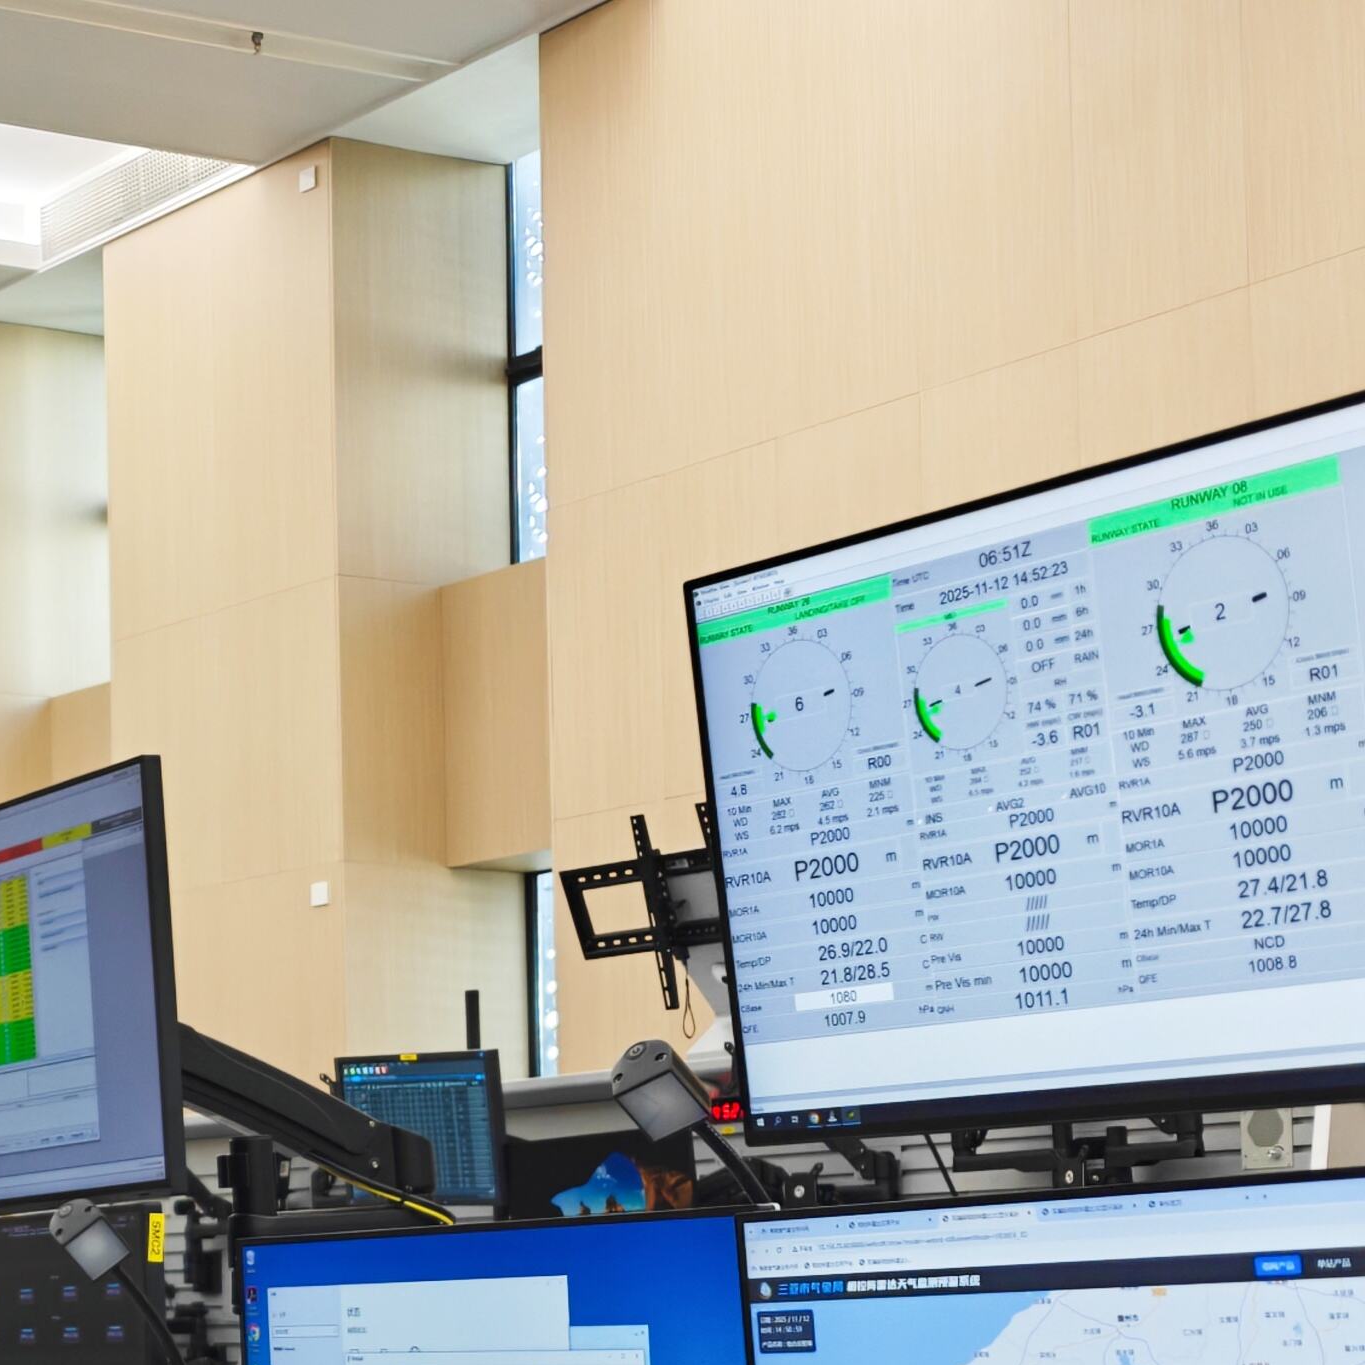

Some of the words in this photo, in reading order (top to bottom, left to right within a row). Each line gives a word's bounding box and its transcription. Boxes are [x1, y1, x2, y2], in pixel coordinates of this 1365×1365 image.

[1170, 485, 1229, 511] RUNWAY
[1232, 480, 1248, 495] 08
[1232, 495, 1254, 508] NOT
[1255, 491, 1267, 502] IN
[1268, 485, 1288, 499] USE
[1091, 527, 1129, 544] RUNWAY
[1131, 519, 1160, 536] STATE
[1206, 520, 1219, 532] 36
[1245, 522, 1259, 534] 03
[979, 541, 1032, 568] 06:51Z
[1170, 541, 1183, 552] 33
[1277, 548, 1291, 560] 06
[940, 575, 1009, 605] 2025-11-12
[1013, 561, 1068, 587] 14:52:23
[1147, 579, 1159, 591] 30
[1020, 595, 1039, 609] 0.0
[1075, 584, 1086, 595] 1h
[1293, 590, 1306, 602] 09
[895, 602, 915, 613] Time
[1215, 603, 1226, 621] 2
[817, 628, 828, 639] 03
[1023, 617, 1042, 631] 0.0
[1142, 624, 1153, 636] 27
[1074, 628, 1094, 641] 24h
[1288, 637, 1301, 648] 12
[841, 651, 852, 662] 06
[1031, 659, 1056, 673] OFF
[1074, 650, 1099, 664] RAIN
[744, 675, 754, 685] 30
[1156, 665, 1169, 677] 24
[1263, 675, 1275, 686] 15
[1309, 664, 1339, 682] R01
[853, 688, 865, 698] 09
[1187, 691, 1198, 702] 21
[1227, 695, 1238, 706] 18
[794, 696, 804, 712] 6
[1028, 701, 1041, 713] 74
[1069, 693, 1082, 704] 71
[1129, 704, 1156, 720] -3.1
[739, 713, 749, 723] 27
[1123, 729, 1135, 741] 10
[1137, 727, 1155, 739] Min
[1183, 716, 1206, 729] MAX
[1246, 705, 1269, 717] AVG
[1307, 692, 1337, 705] MNM
[1032, 730, 1059, 747] -3.6
[1073, 722, 1100, 740] R01
[1131, 742, 1150, 753] WD
[1180, 731, 1199, 744] 287
[1243, 719, 1263, 732] 250
[1307, 707, 1328, 720] 206
[1132, 757, 1151, 768] WS
[1178, 748, 1194, 761] 5.6
[1196, 746, 1217, 758] mps
[1240, 737, 1256, 749] 3.7
[1259, 734, 1281, 747] mps
[1305, 725, 1321, 737] 1.3
[1324, 722, 1346, 734] mps
[831, 760, 842, 769] 15
[867, 755, 891, 770] R00
[1119, 777, 1151, 790] RVR1A
[1232, 750, 1285, 773] P2000
[773, 796, 791, 808] MAX
[822, 787, 840, 798] AVG
[925, 812, 943, 825] INS
[996, 798, 1024, 812] AVG2
[1069, 782, 1107, 799] AVG10
[1121, 802, 1182, 825] RVR10A
[1212, 778, 1293, 814] P2000
[1329, 776, 1344, 790] m
[1009, 807, 1055, 829] P2000
[810, 826, 851, 846] P2000
[1126, 837, 1165, 854] MOR1A
[1229, 814, 1288, 841] 10000
[923, 852, 972, 871] RVR10A
[995, 833, 1060, 863] P2000
[1087, 833, 1099, 844] m
[725, 870, 772, 889] RVR10A
[794, 852, 859, 882] P2000
[886, 851, 897, 862] m
[1129, 865, 1175, 881] MOR10A
[1233, 844, 1292, 869] 10000
[926, 886, 966, 900] MOR10A
[1005, 867, 1057, 891] 10000
[1131, 894, 1177, 910] Temp/DP
[1238, 869, 1329, 900] 27.4/21.8
[809, 887, 854, 908] 10000
[812, 914, 857, 936] 10000
[1134, 928, 1154, 940] 24h
[1157, 921, 1202, 938] Min/Max
[1241, 900, 1332, 930] 22.7/27.8
[818, 937, 888, 962] 26.9/22.0
[920, 934, 927, 944] C
[931, 954, 946, 965] Pre
[1017, 935, 1065, 956] 10000
[1254, 935, 1286, 951] NCD
[820, 961, 891, 986] 21.8/28.5
[922, 959, 931, 969] C
[1248, 955, 1298, 974] 1008.8
[935, 979, 952, 991] Pre
[955, 977, 971, 989] Vis
[973, 975, 993, 987] min
[1019, 961, 1073, 984] 10000
[830, 990, 858, 1004] 1080
[1015, 988, 1070, 1010] 1011.1
[824, 1010, 866, 1028] 1007.9
